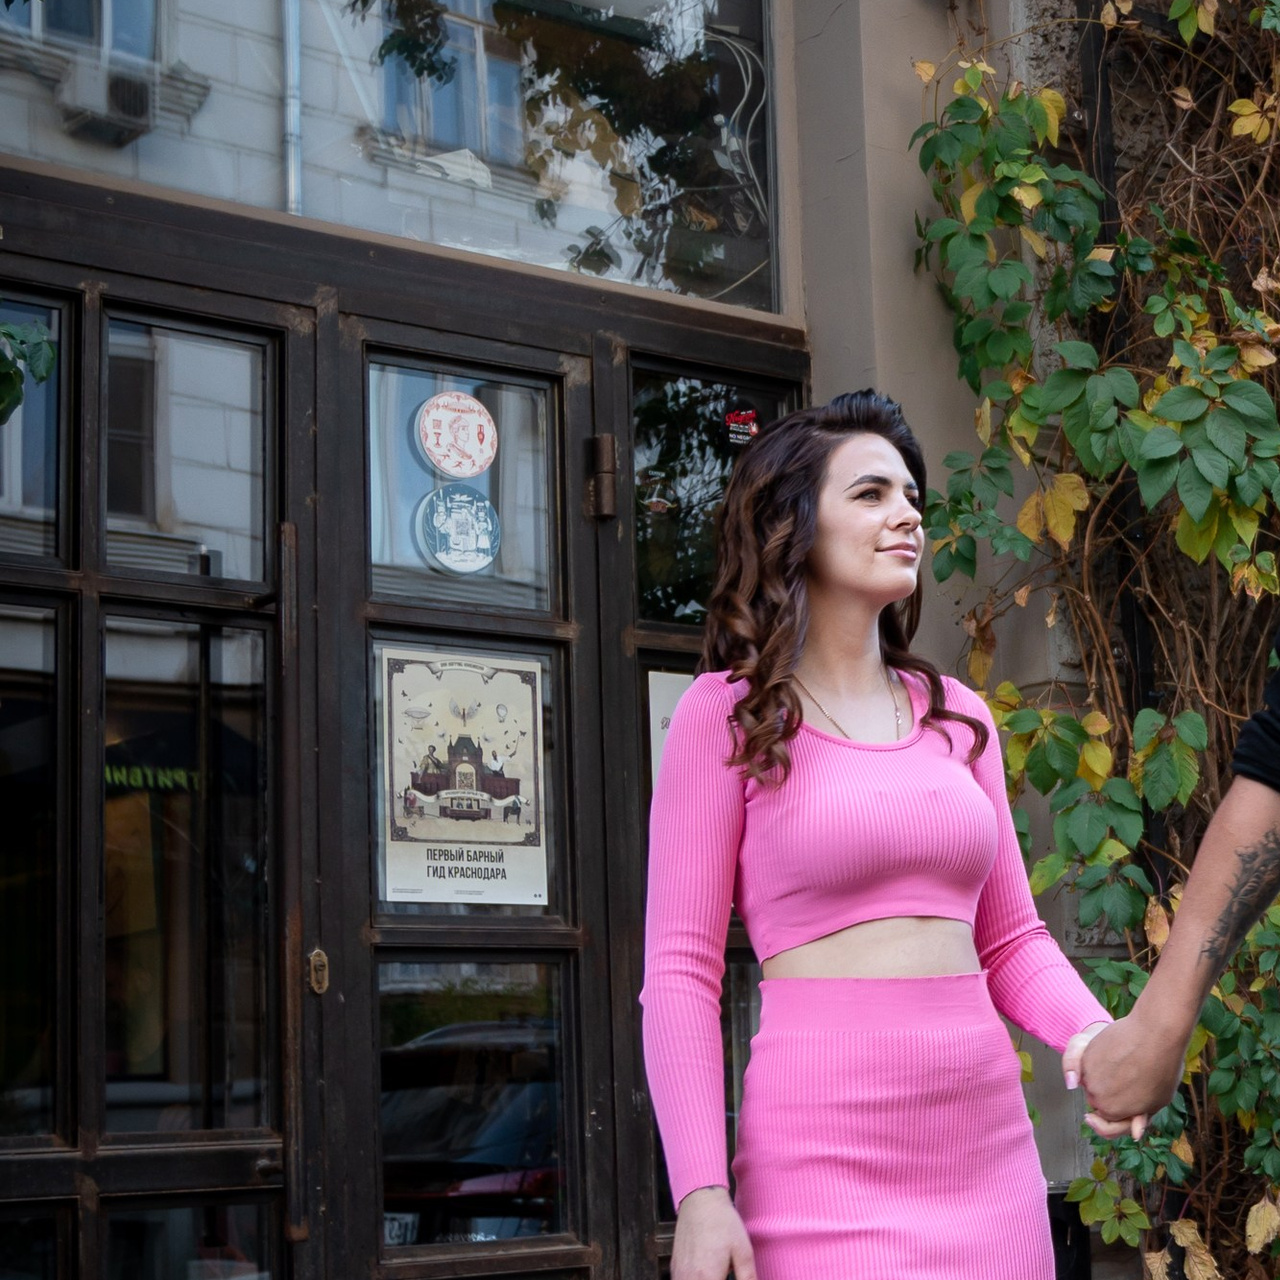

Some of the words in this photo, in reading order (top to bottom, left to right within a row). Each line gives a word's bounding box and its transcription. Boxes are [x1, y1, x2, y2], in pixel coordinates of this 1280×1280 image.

[426, 847, 465, 862] ПЕРВЫЙ
[466, 849, 504, 863] БАРНЫЙ
[427, 865, 446, 879] ГИД
[447, 866, 507, 881] КРАСНОДАРА
